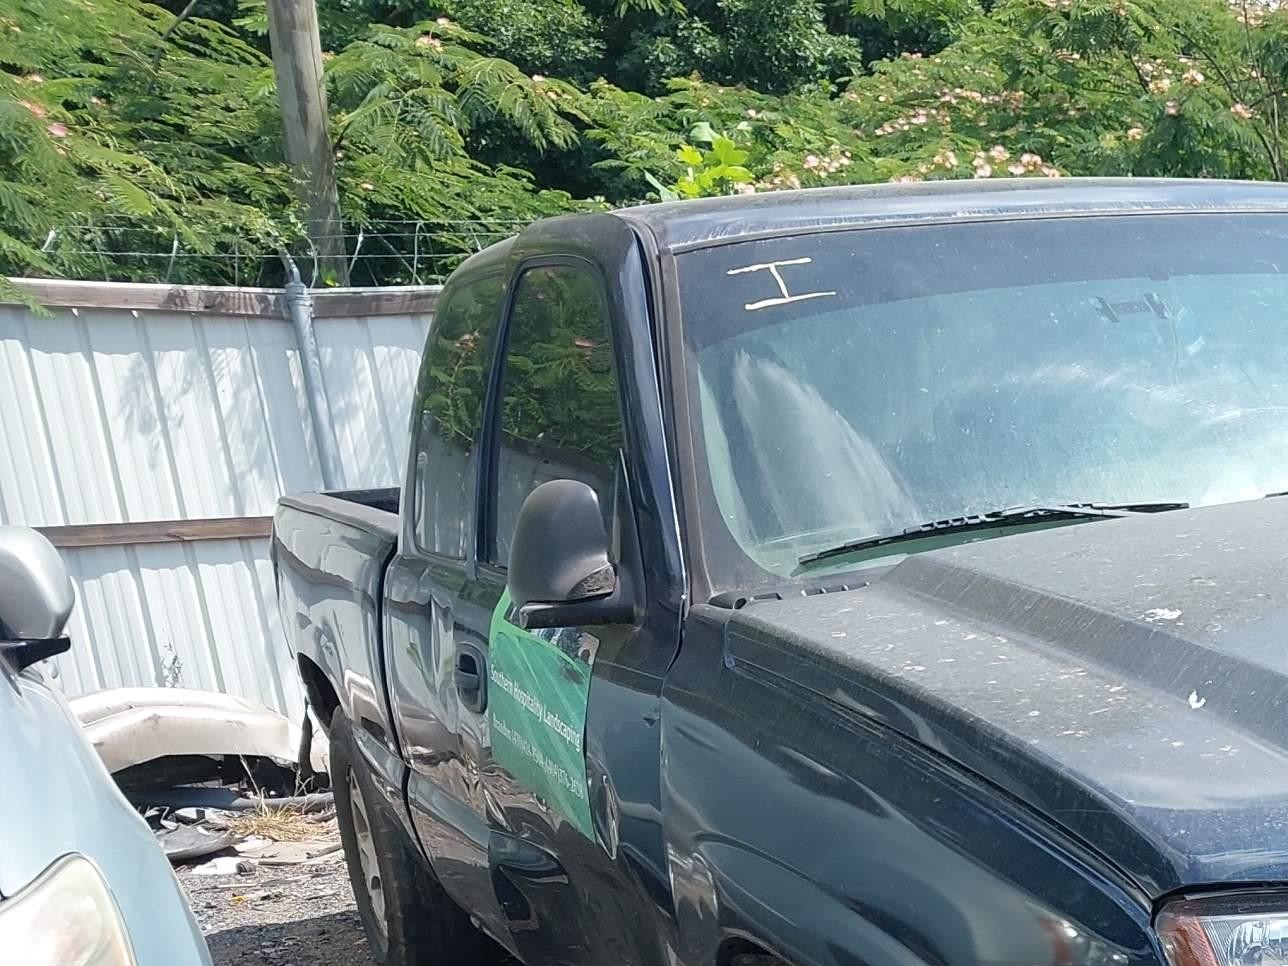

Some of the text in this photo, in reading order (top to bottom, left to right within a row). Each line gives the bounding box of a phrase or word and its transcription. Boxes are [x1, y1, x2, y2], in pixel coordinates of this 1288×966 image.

[490, 663, 580, 753] Southern Hospitality Landscaping
